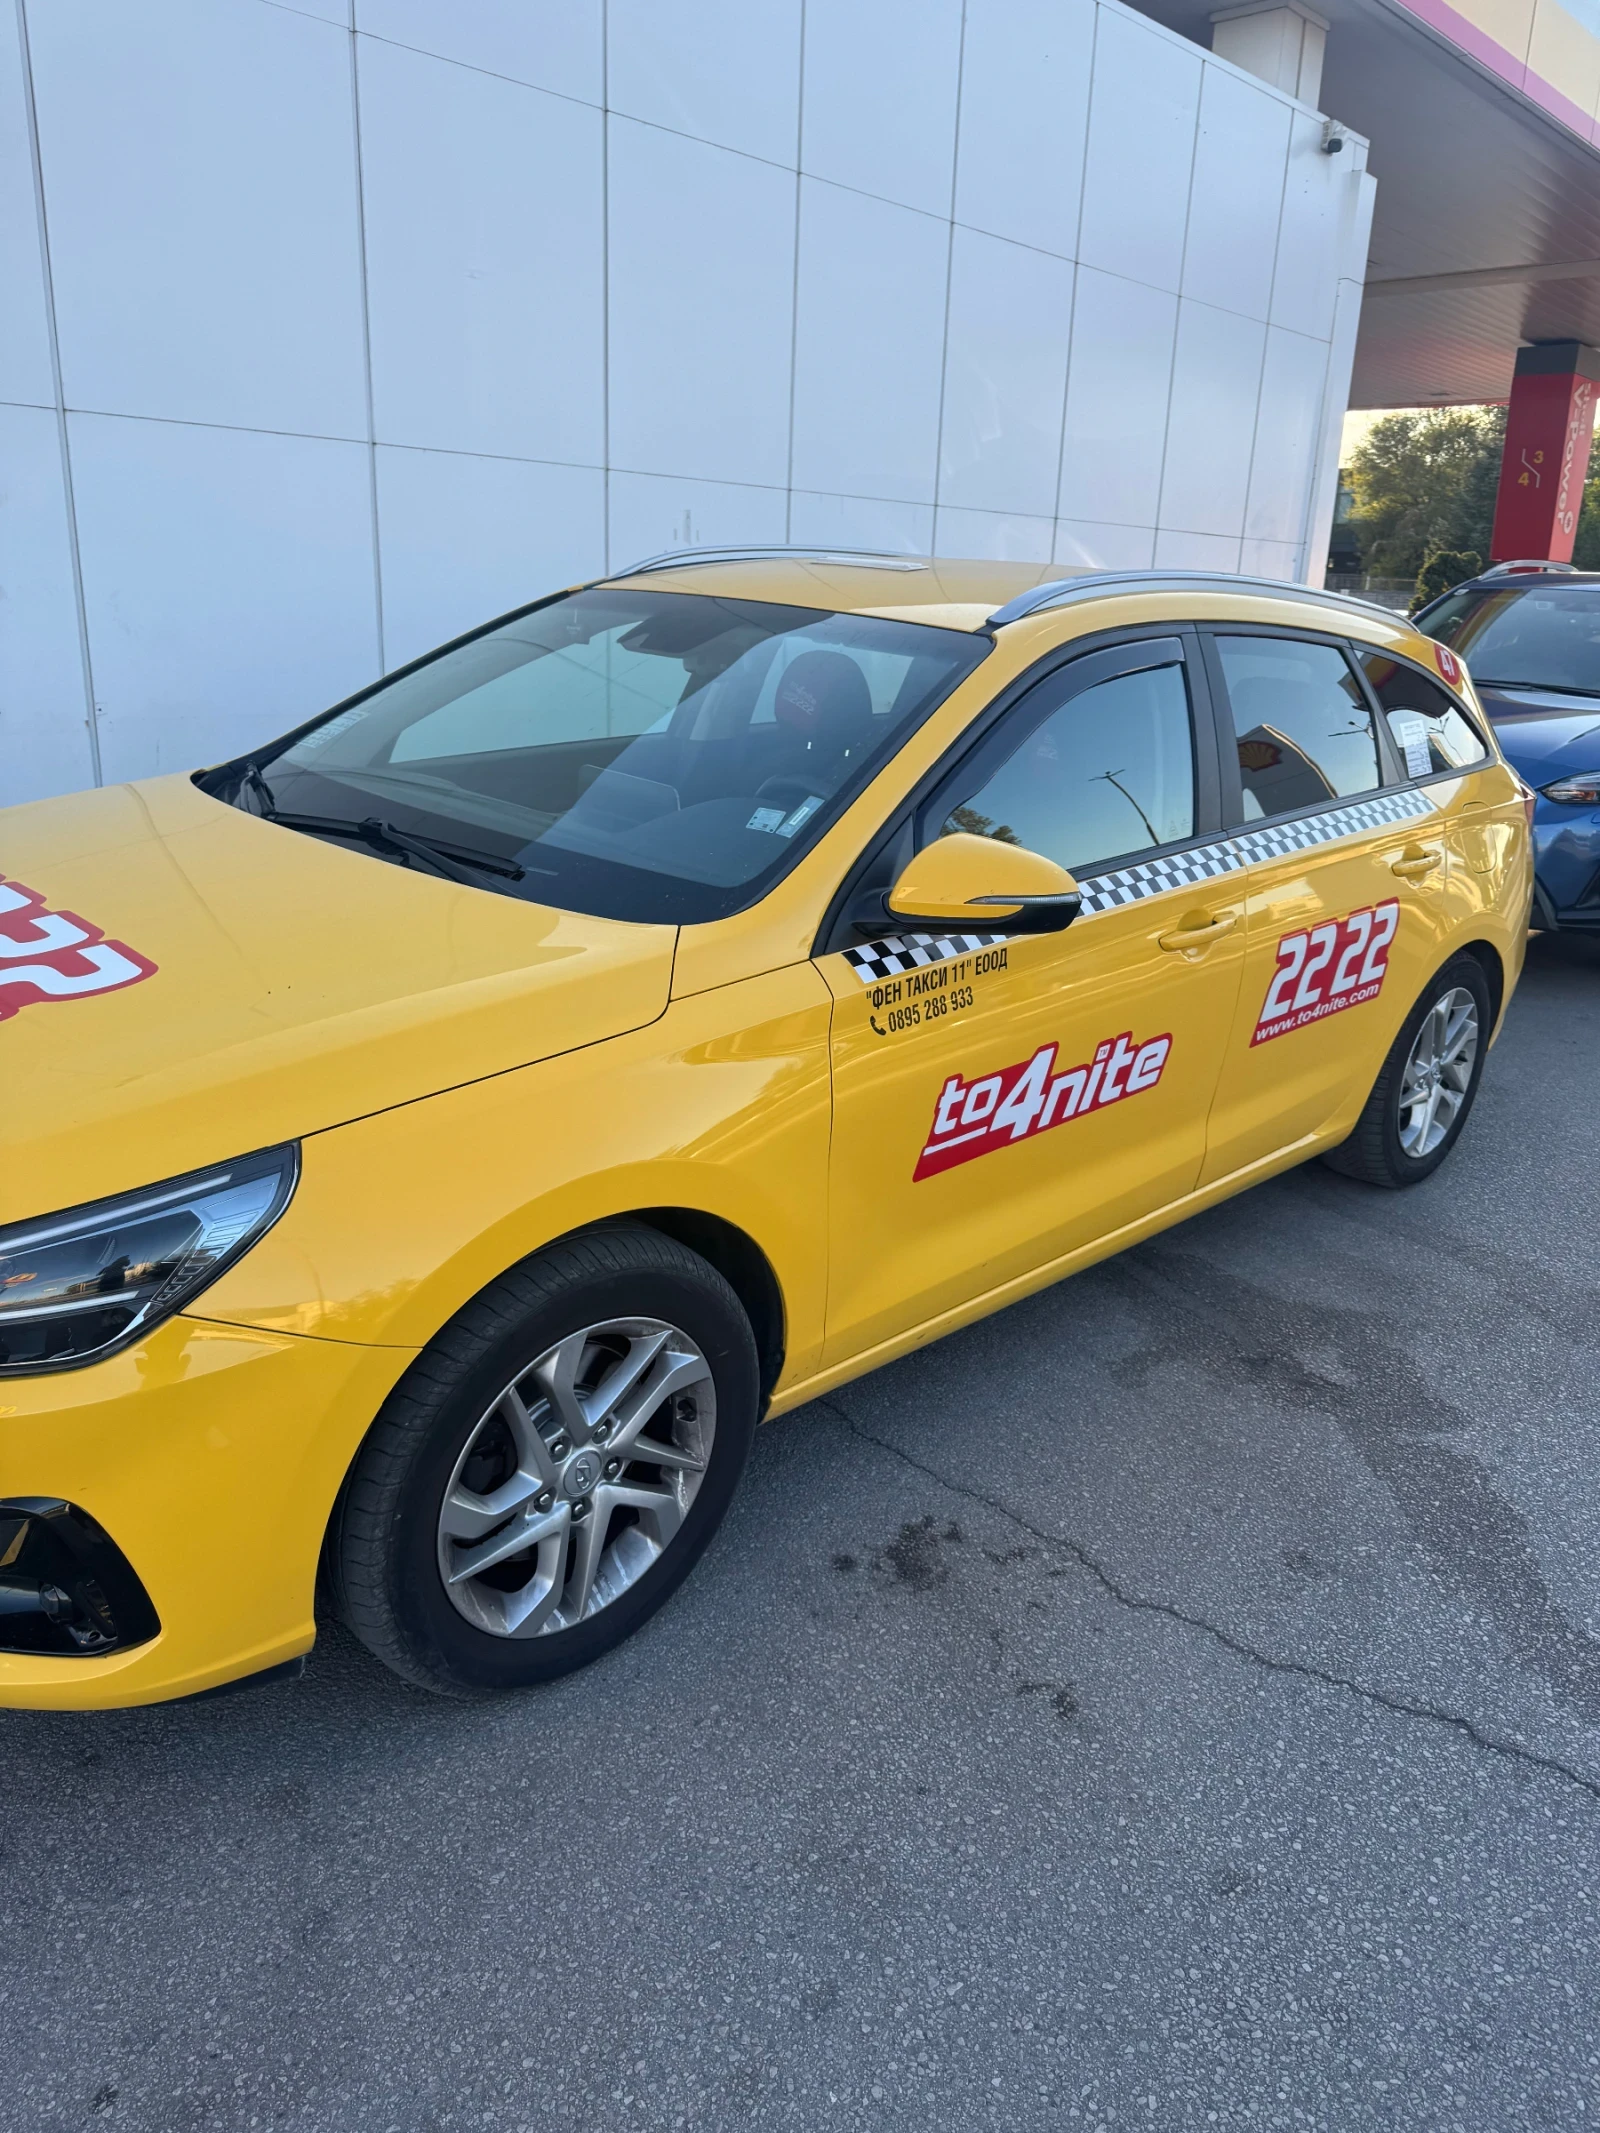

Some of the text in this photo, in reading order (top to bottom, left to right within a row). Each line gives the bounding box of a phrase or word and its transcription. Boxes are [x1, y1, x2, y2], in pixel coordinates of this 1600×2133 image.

[1518, 472, 1530, 487] 4
[1533, 451, 1544, 464] 3
[866, 947, 1008, 1010] "ФЕН ТАКСИ 11" ЕООД
[888, 986, 974, 1033] 0895 288 933
[1256, 984, 1380, 1041] www.to4nite.com
[934, 1037, 1170, 1140] to4nite
